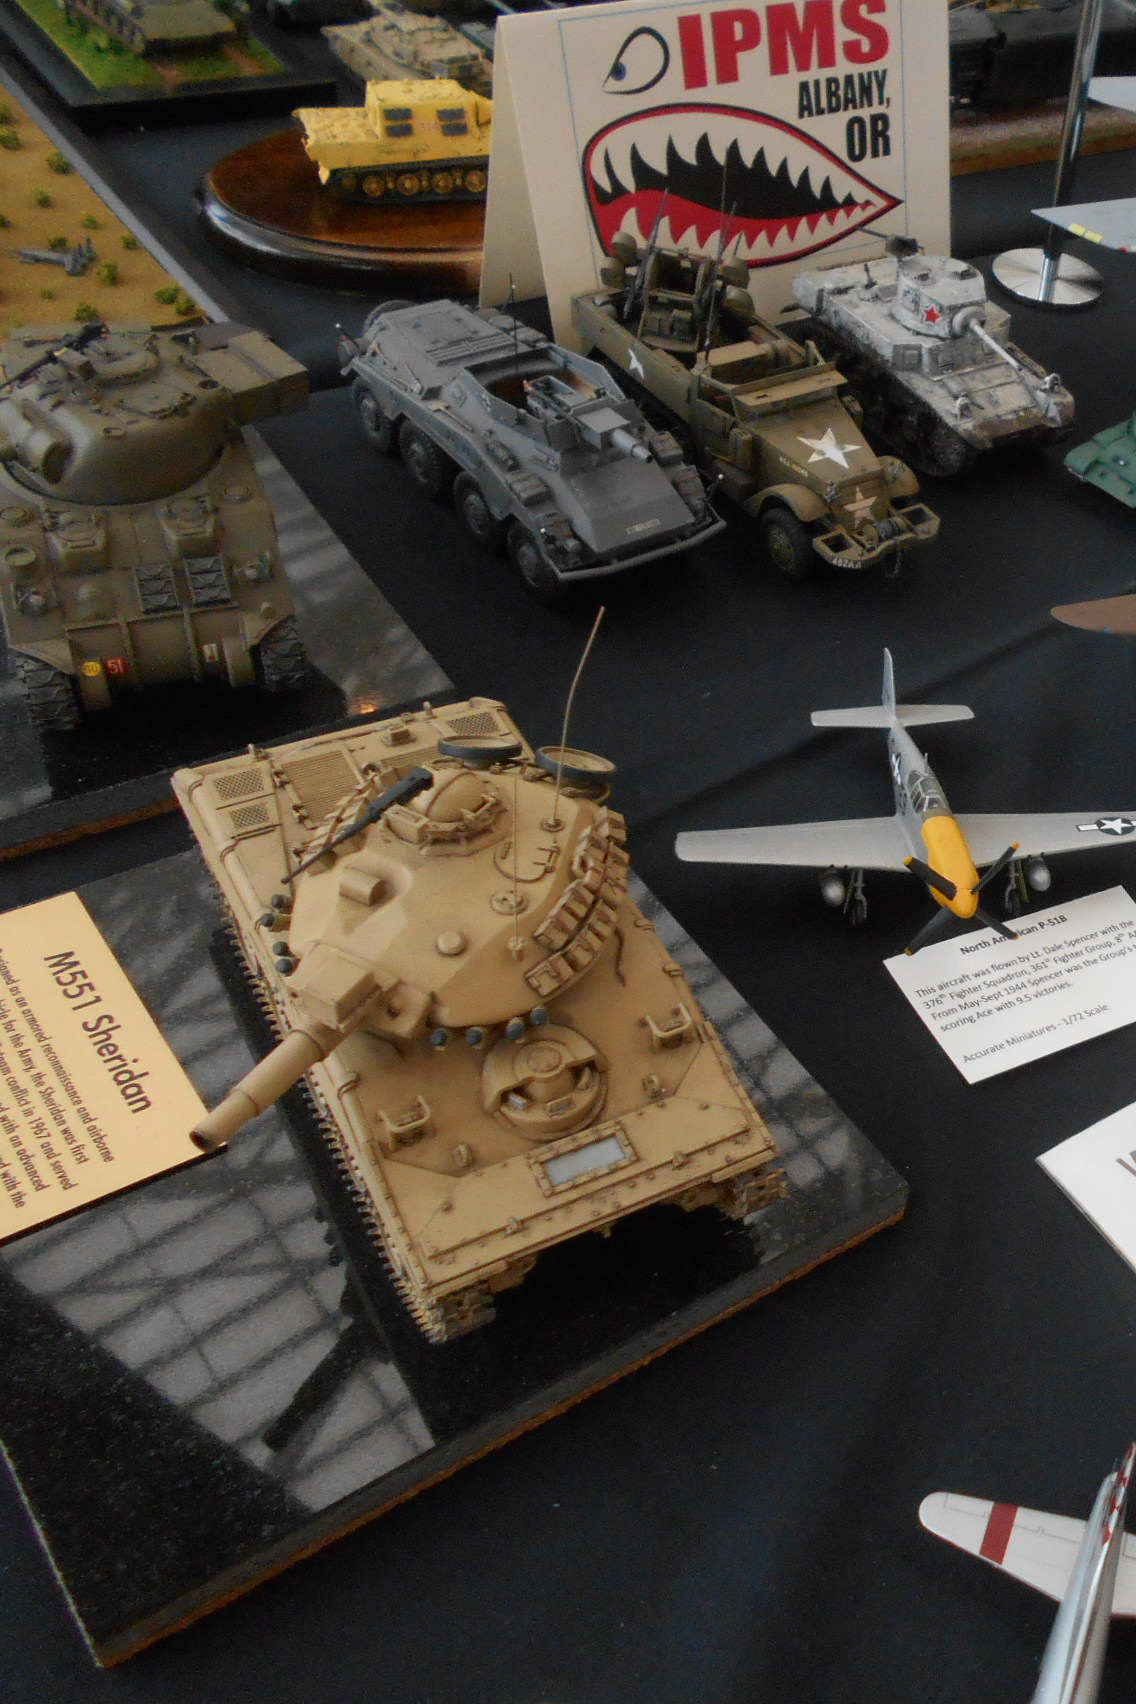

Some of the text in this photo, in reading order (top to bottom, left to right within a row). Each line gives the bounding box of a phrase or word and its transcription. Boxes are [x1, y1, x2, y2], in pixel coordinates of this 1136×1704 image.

[677, 0, 890, 90] IPMS
[798, 68, 890, 120] ALBANY,
[846, 112, 891, 163] OR
[107, 657, 125, 675] 51
[959, 914, 1067, 954] North Amican P-51B
[914, 920, 1134, 997] This aircraft was flown by Lt. Dale Spencer with the
[948, 984, 982, 1000] Fighter
[982, 969, 1031, 988] Squadron,
[1052, 949, 1084, 964] Fighter
[1084, 940, 1116, 953] Group,
[8, 985, 22, 997] as
[930, 1007, 958, 1020] From
[957, 990, 1004, 1010] May-Sept
[1003, 981, 1027, 995] 1944
[1027, 970, 1063, 986] Spencer
[1063, 963, 1083, 973] was
[1082, 958, 1099, 967] the
[1098, 946, 1133, 961] Group's
[14, 996, 28, 1008] an
[940, 981, 1071, 1032] scoring Ace with 9.5 victories.
[4, 1019, 16, 1033] for
[20, 1008, 53, 1043] armored
[43, 950, 152, 1114] M551 Sheridan
[963, 1043, 1005, 1063] Accurate
[1005, 1024, 1057, 1046] Miniatures
[1061, 1012, 1085, 1025] 1/72
[1083, 1004, 1108, 1017] Scale
[9, 1032, 25, 1049] the
[16, 1048, 37, 1073] Army,
[39, 1043, 83, 1106] reconnaissance
[6, 1075, 32, 1107] conflict
[29, 1071, 47, 1088] the
[20, 1105, 35, 1118] in
[38, 1085, 67, 1127] Sheridan
[75, 1106, 98, 1125] and
[2, 1117, 20, 1134] with
[27, 1116, 52, 1139] 1967
[59, 1126, 77, 1146] was
[9, 1134, 23, 1148] an
[39, 1141, 62, 1160] and
[69, 1143, 90, 1165] first
[86, 1124, 114, 1163] airborne
[2, 1172, 22, 1192] with
[15, 1148, 51, 1192] advanced
[49, 1159, 79, 1191] served
[10, 1190, 27, 1208] the
